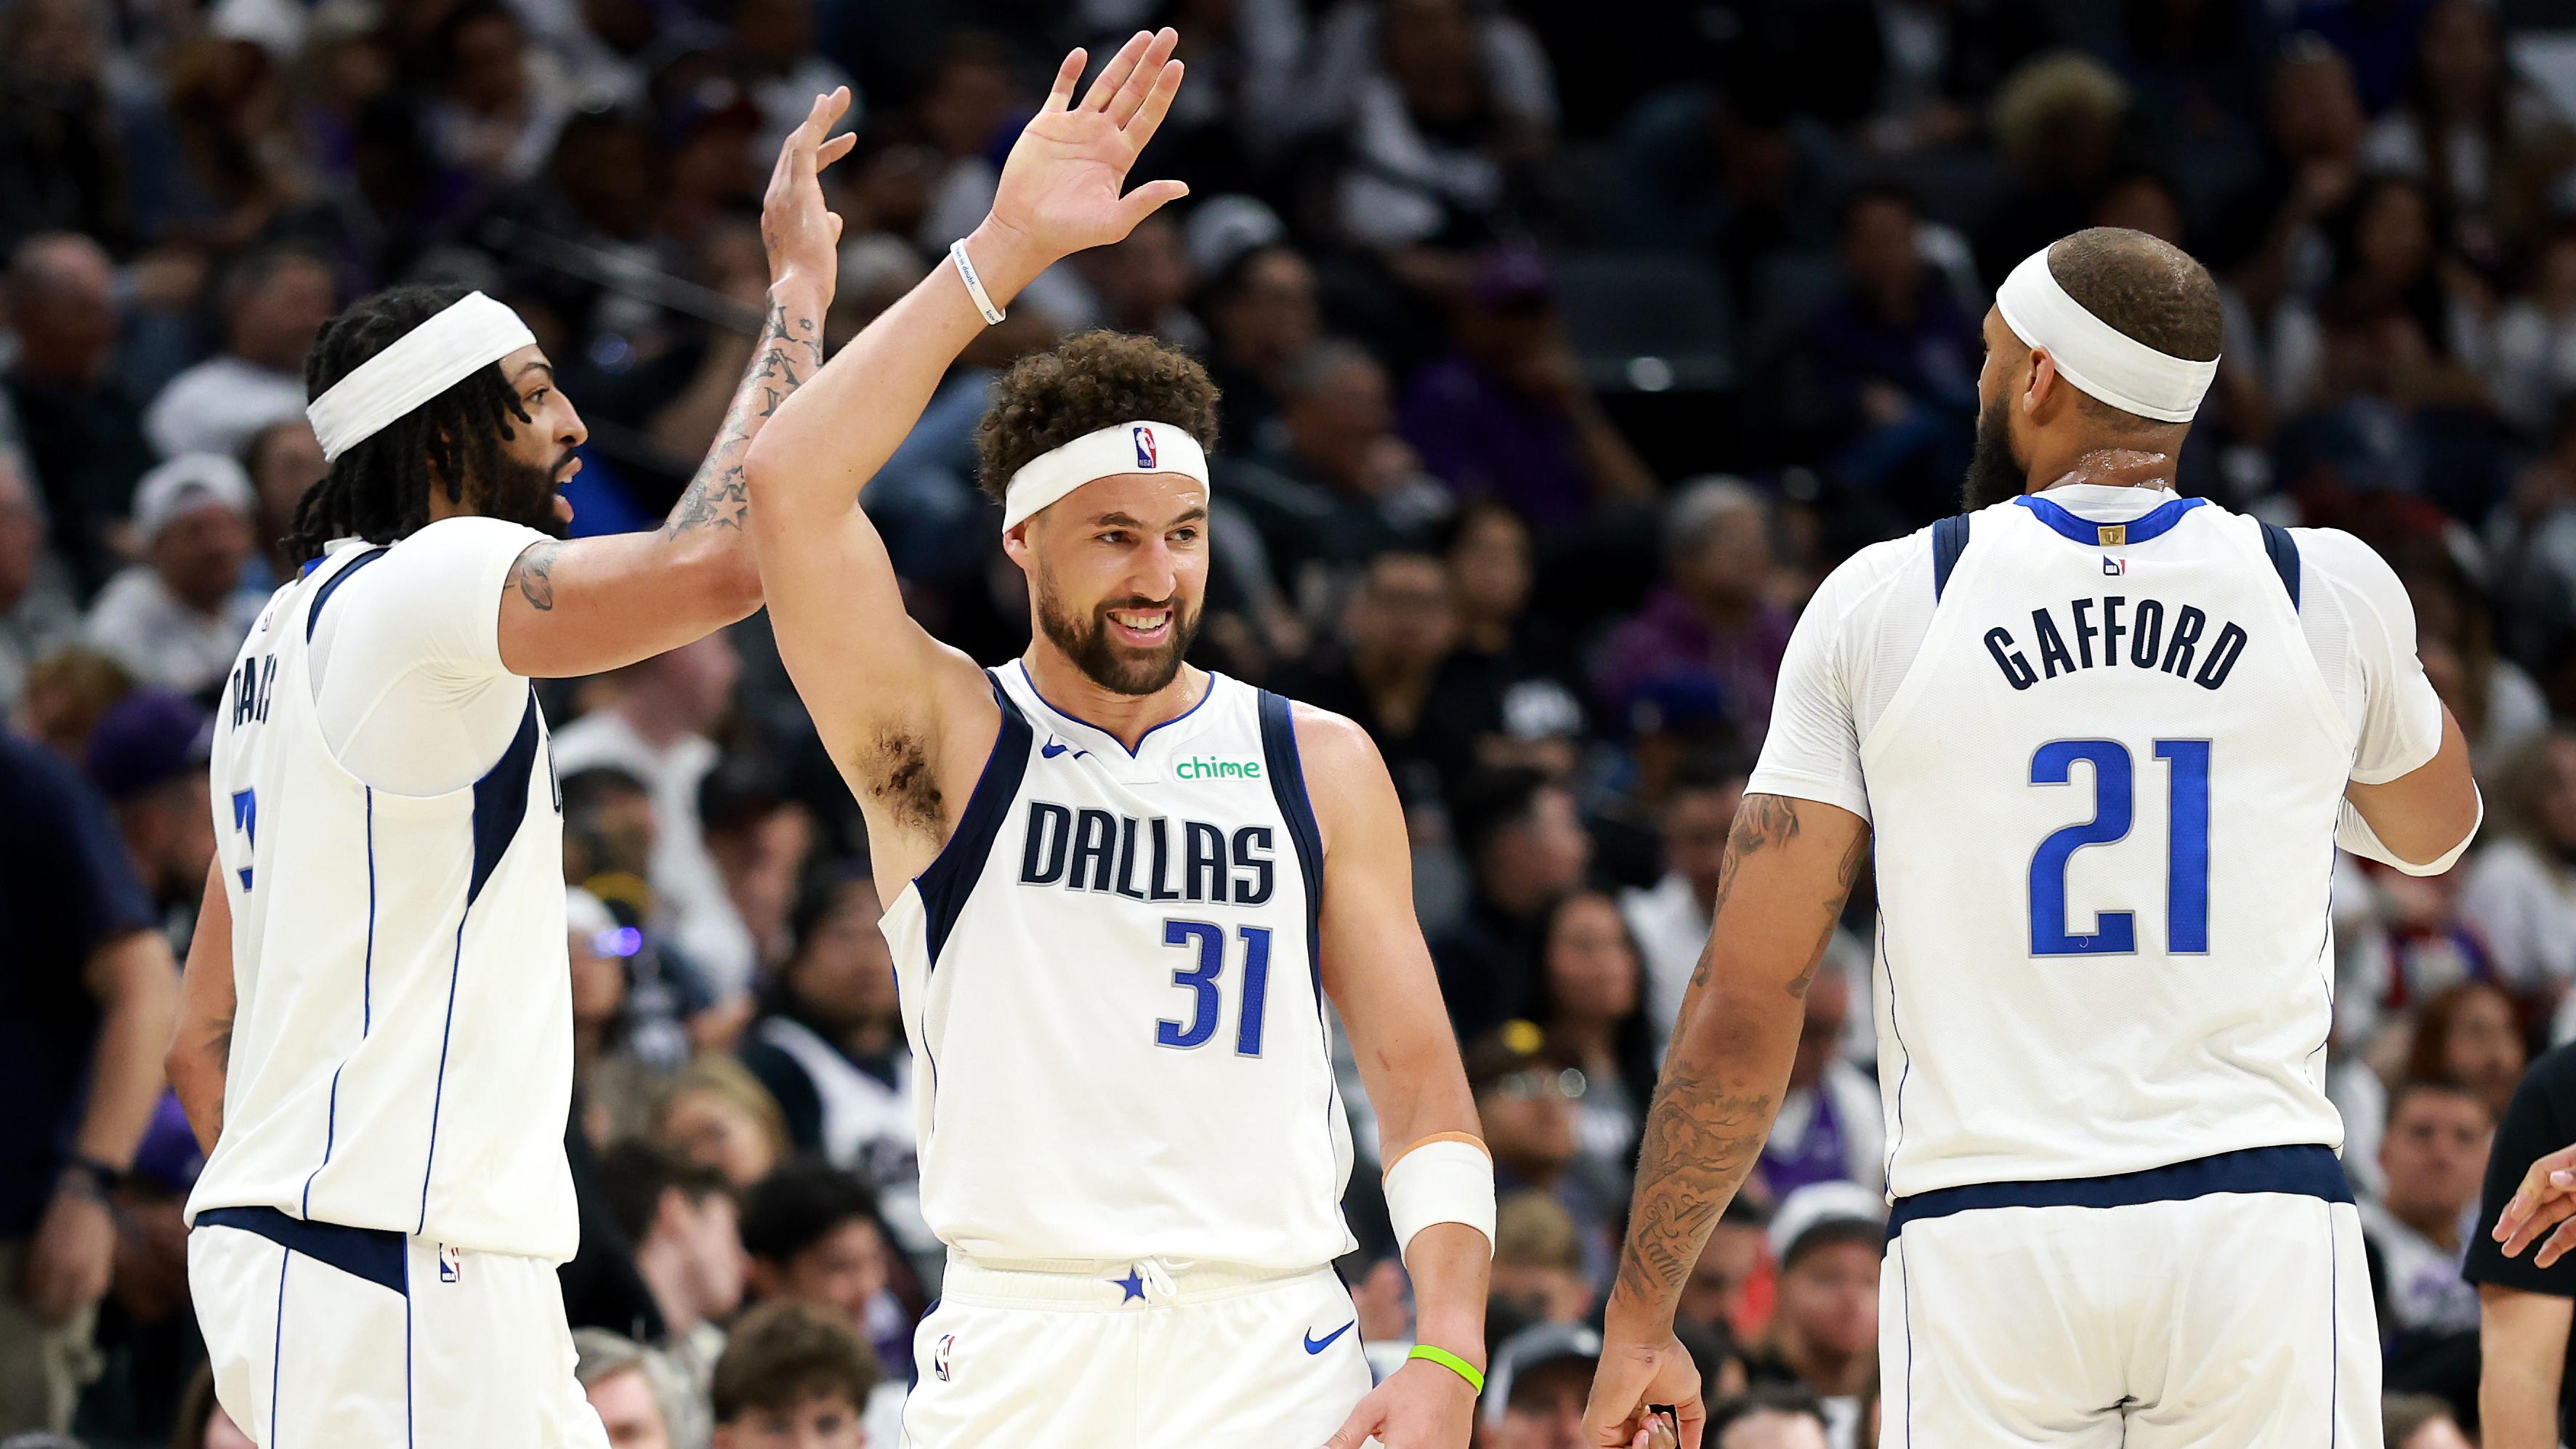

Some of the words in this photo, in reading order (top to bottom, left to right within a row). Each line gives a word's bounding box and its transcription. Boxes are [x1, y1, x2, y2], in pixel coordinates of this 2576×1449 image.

[1984, 596, 2248, 691] GAFFORD
[1176, 756, 1261, 779] chime
[1017, 799, 1275, 908] DALLAS
[2026, 738, 2213, 958] 21
[1154, 917, 1273, 1059] 31
